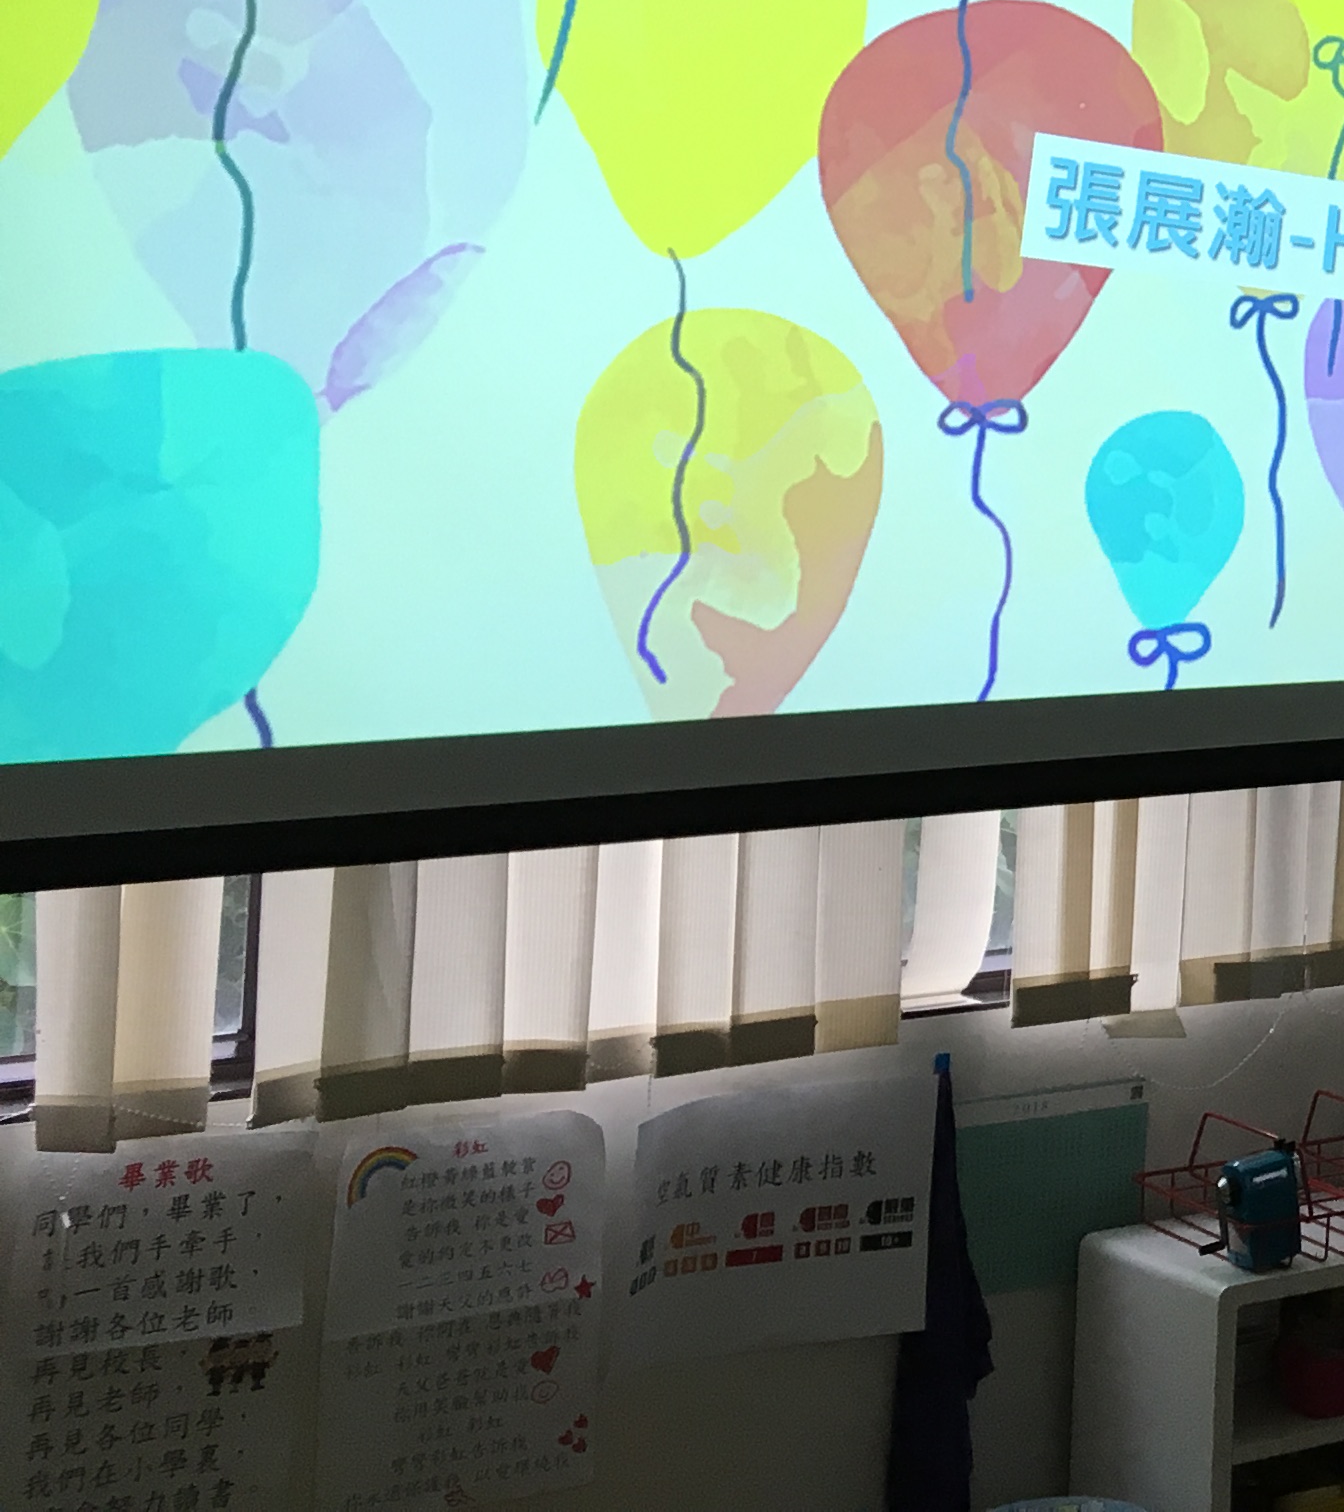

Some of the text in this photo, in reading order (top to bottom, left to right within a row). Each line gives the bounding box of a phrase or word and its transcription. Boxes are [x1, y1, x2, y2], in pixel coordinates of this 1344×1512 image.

[453, 1139, 489, 1159] 彩虹
[117, 1157, 215, 1191] 畢業歌
[656, 1150, 878, 1207] 空氣質素健康指數
[396, 1258, 533, 1289] 一二三四五六七
